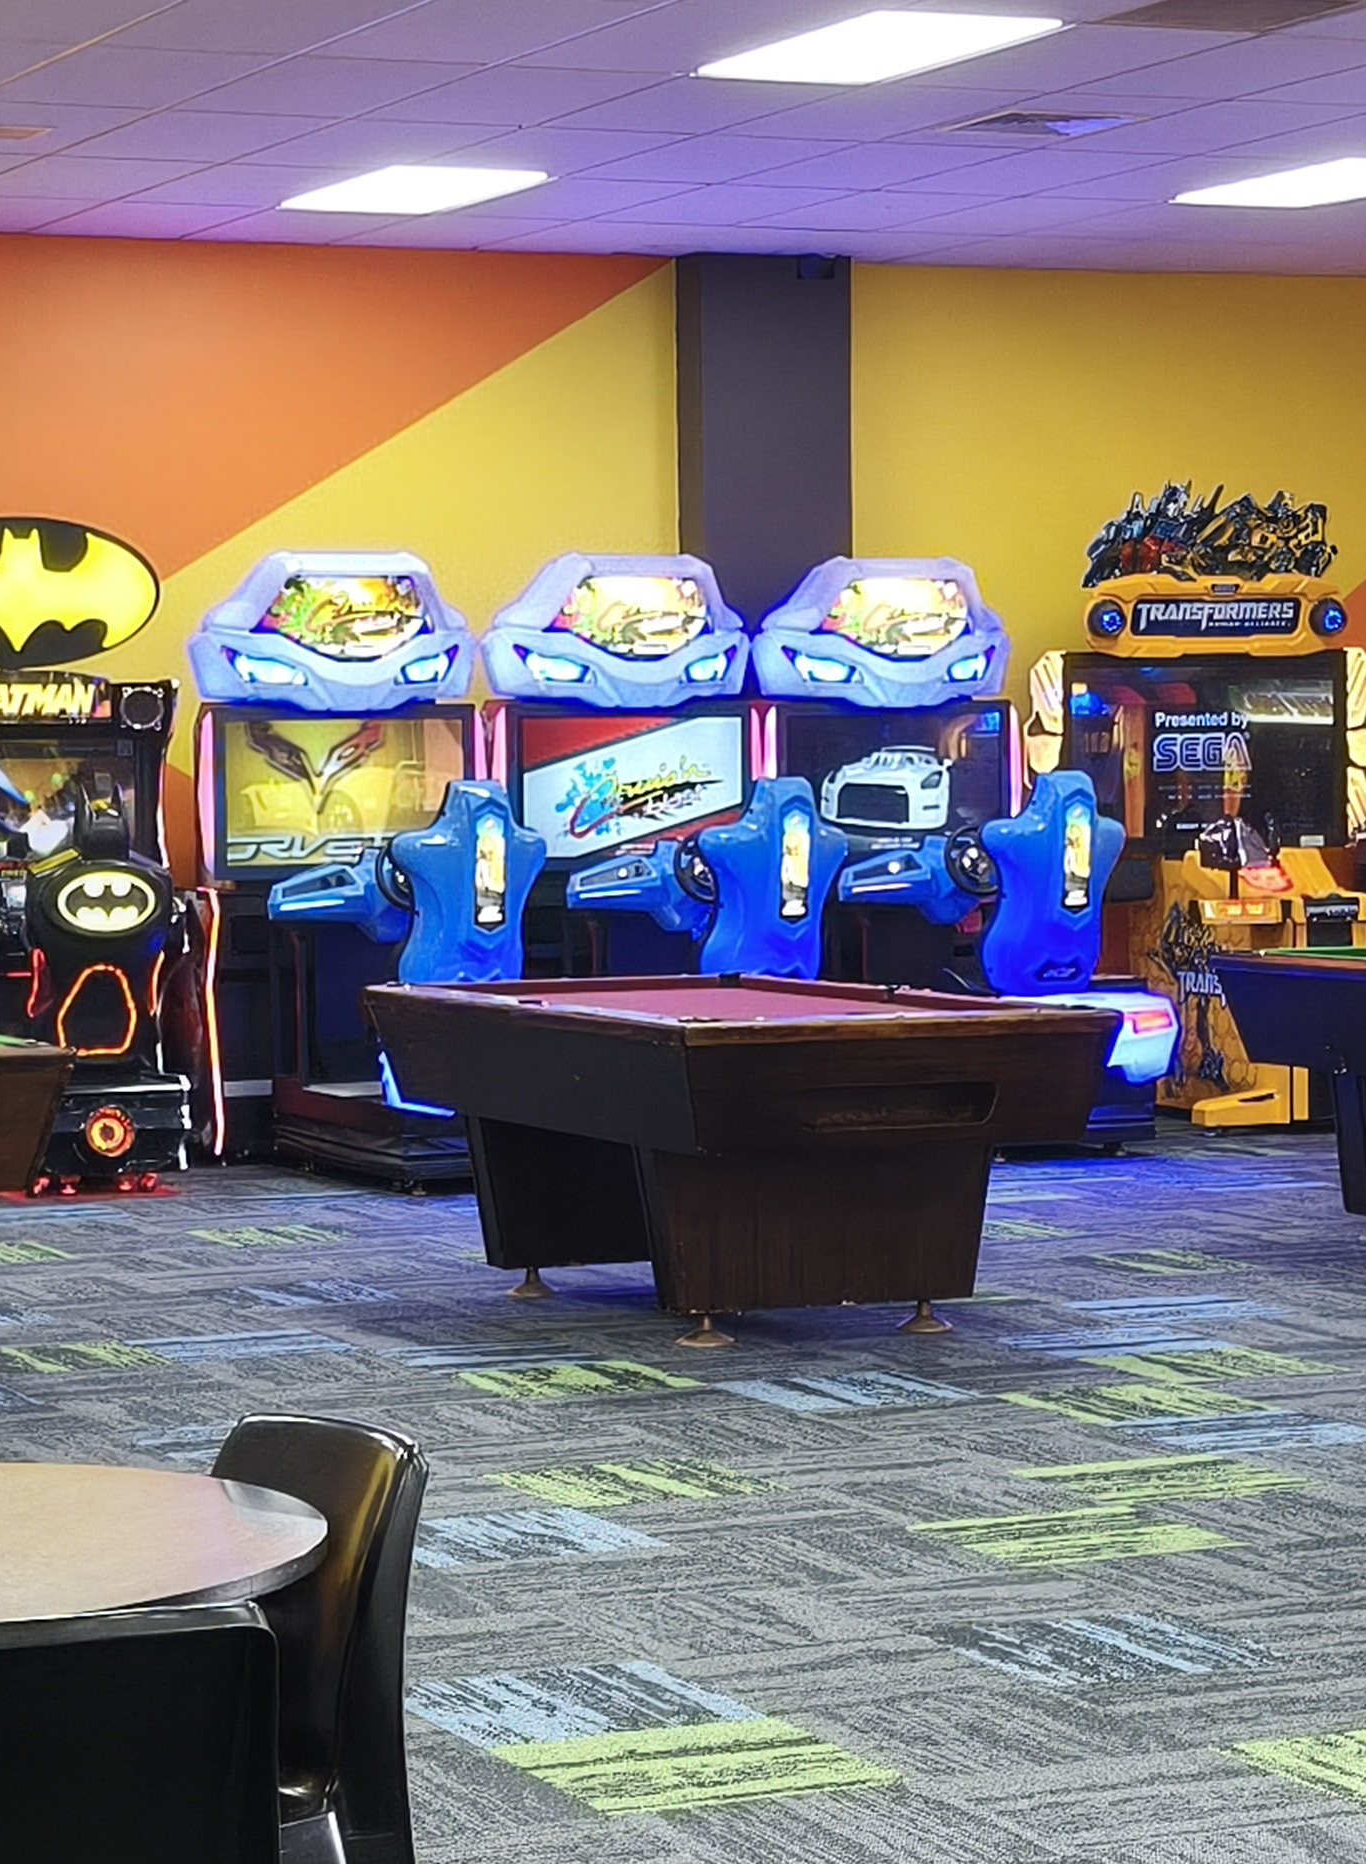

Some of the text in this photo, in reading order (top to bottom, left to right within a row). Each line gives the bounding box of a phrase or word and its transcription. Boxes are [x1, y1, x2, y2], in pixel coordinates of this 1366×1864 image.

[1137, 601, 1295, 632] TRANSFORMERS
[1155, 711, 1249, 730] Presented by
[1153, 732, 1253, 772] SEGA
